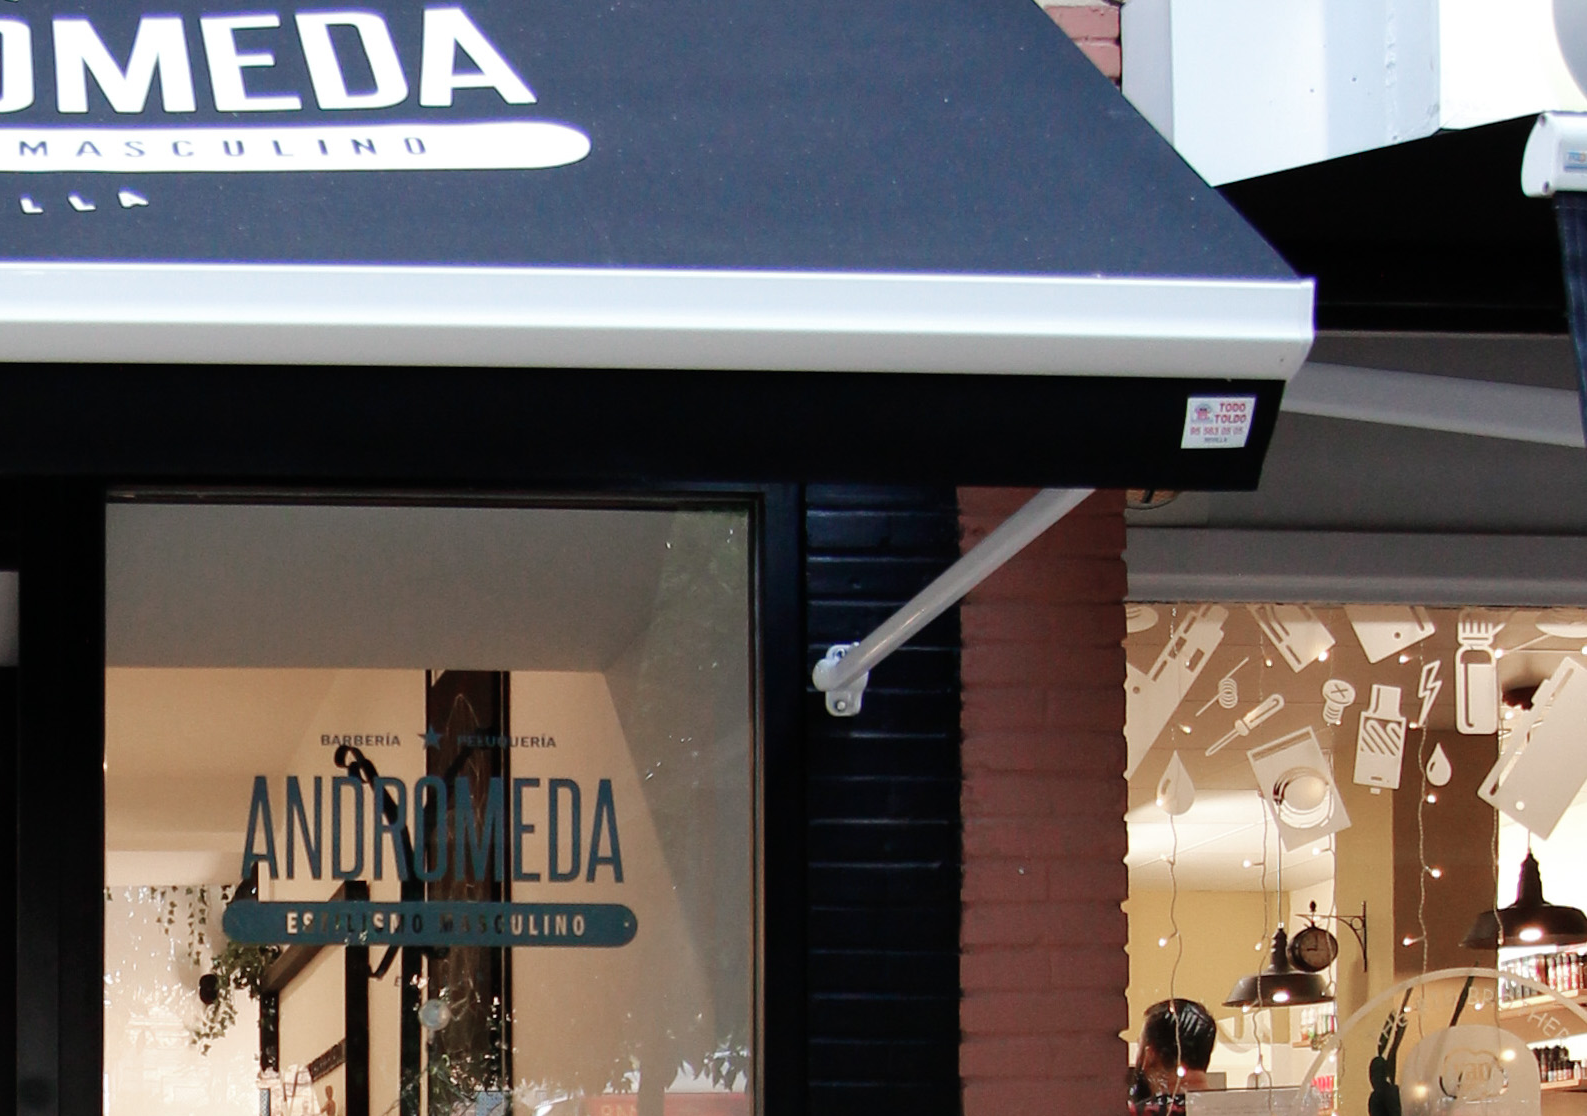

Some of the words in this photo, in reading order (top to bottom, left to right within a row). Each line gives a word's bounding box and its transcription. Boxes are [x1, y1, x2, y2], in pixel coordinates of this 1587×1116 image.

[18, 136, 428, 159] MASCULINO
[320, 732, 401, 747] BARBERÍA
[241, 774, 624, 884] ANDROMEDA
[439, 911, 586, 937] MASCULINO
